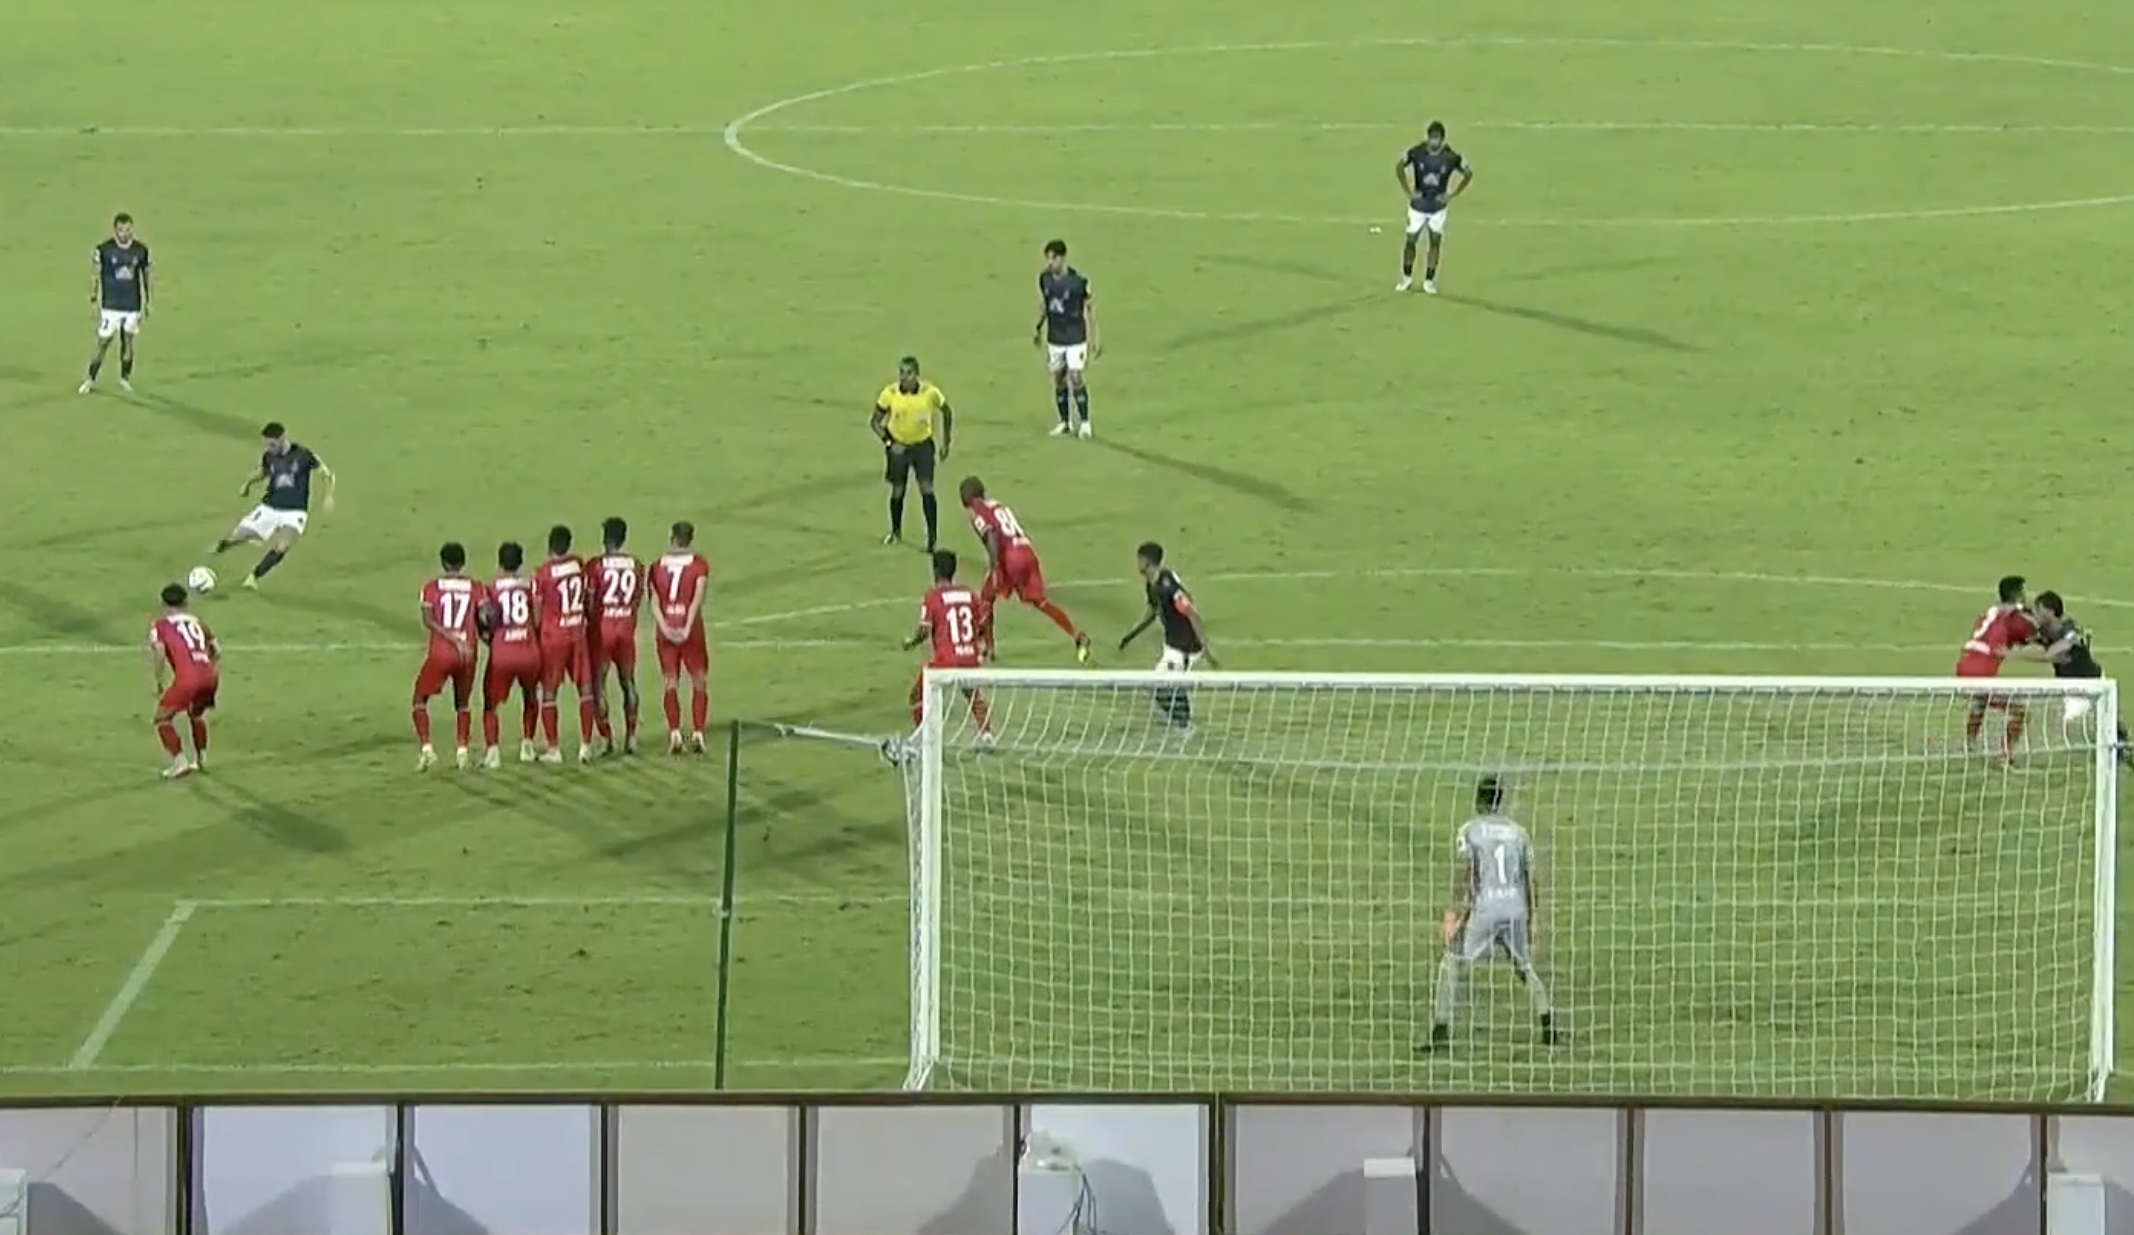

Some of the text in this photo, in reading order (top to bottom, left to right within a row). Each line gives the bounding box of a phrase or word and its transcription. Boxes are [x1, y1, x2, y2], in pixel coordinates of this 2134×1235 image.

[557, 576, 584, 615] 12
[602, 568, 637, 606] 29
[666, 565, 684, 601] 7
[440, 592, 470, 629] 17
[498, 590, 529, 625] 18
[946, 606, 974, 644] 13
[176, 622, 205, 651] 19
[1494, 844, 1507, 884] 1
